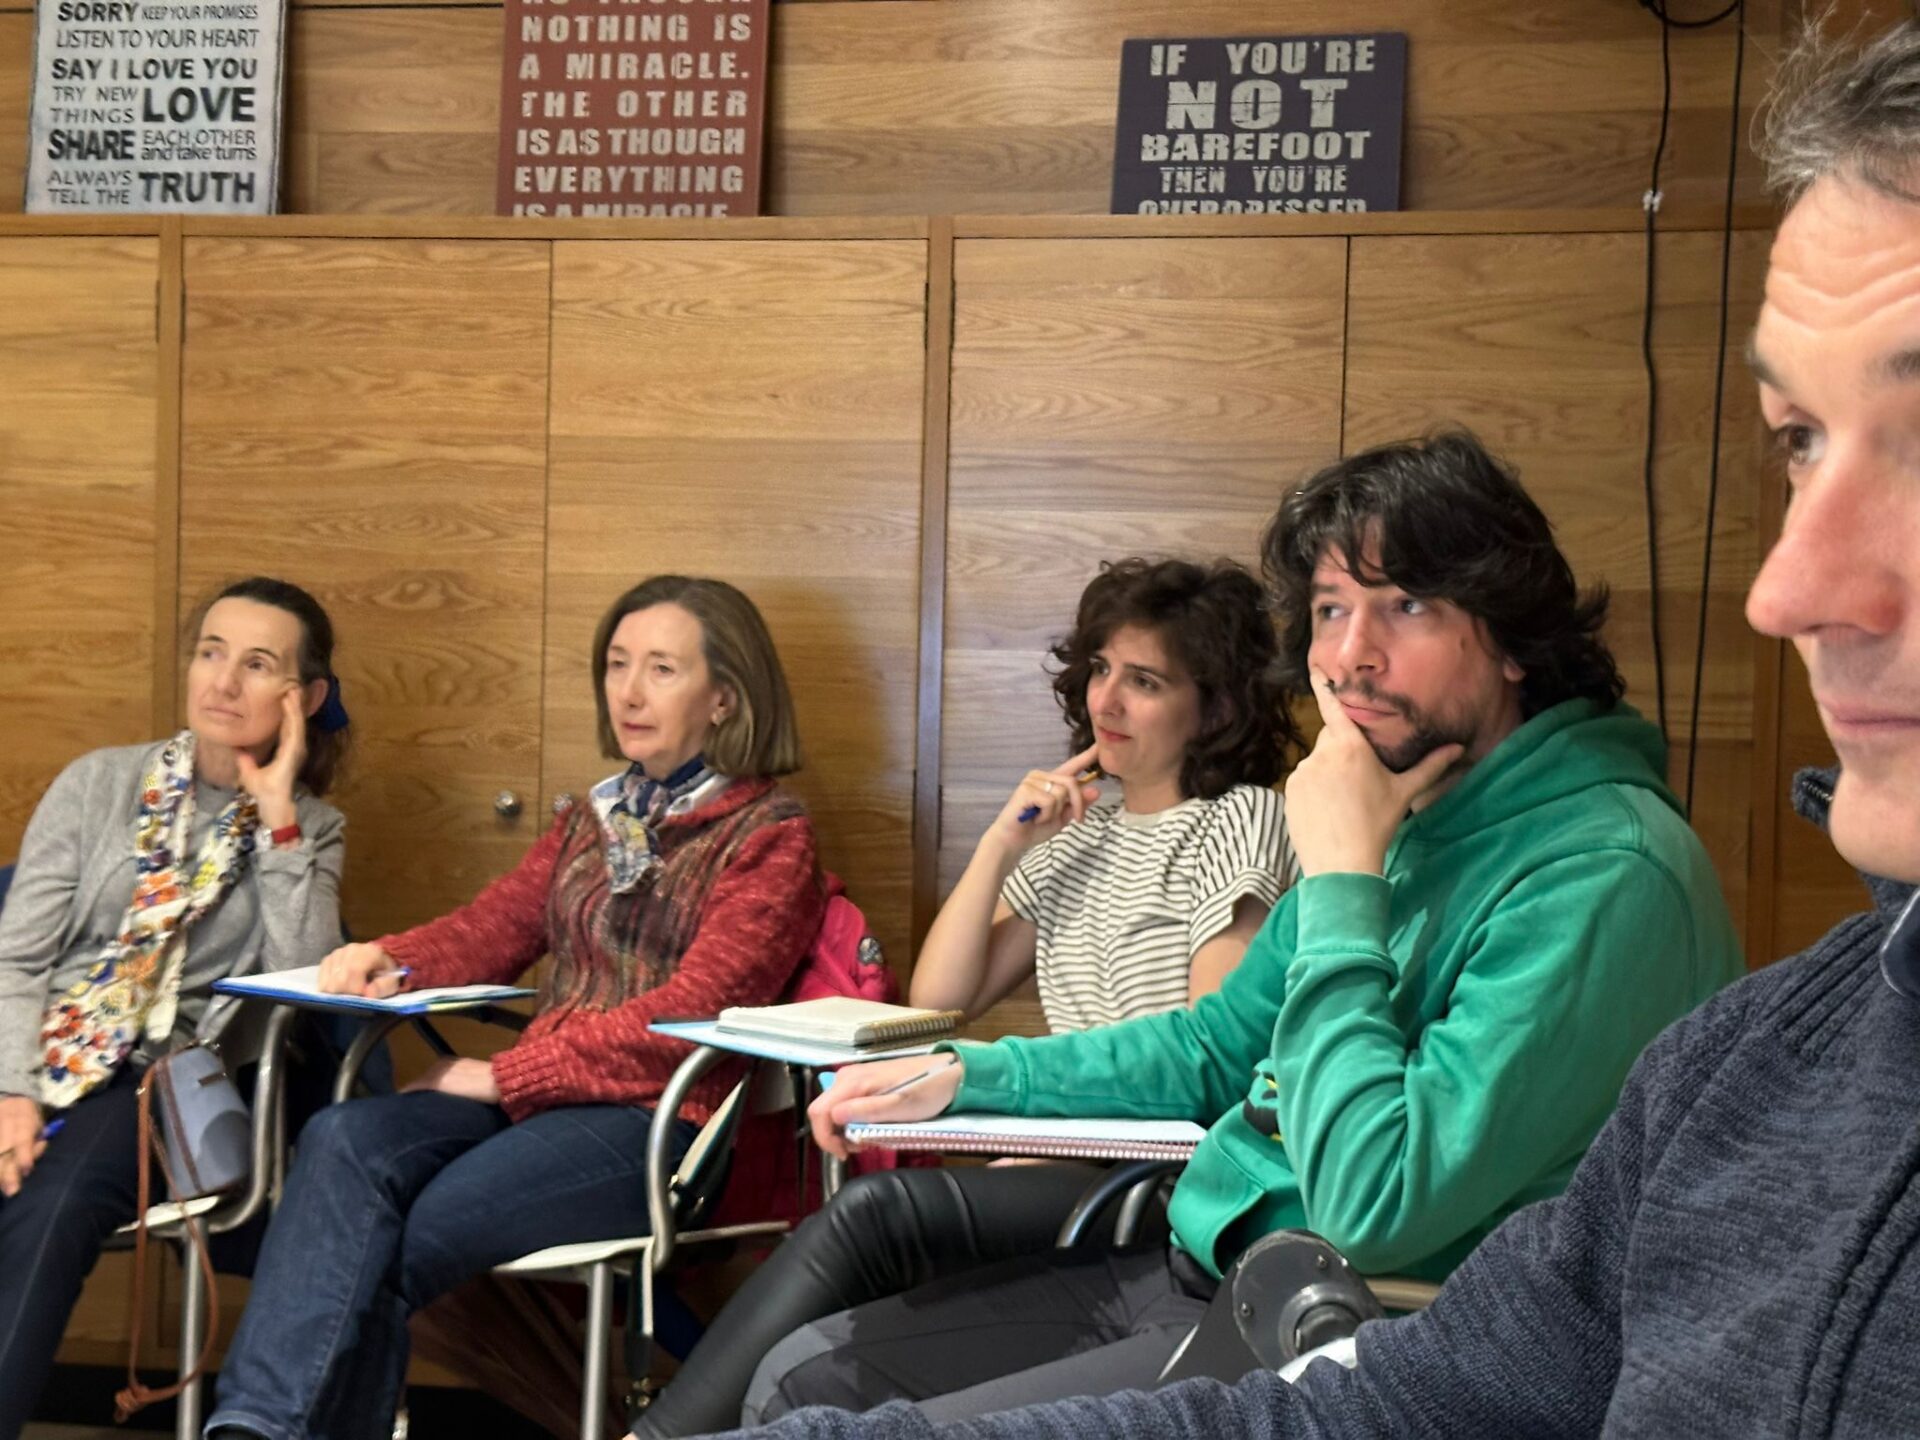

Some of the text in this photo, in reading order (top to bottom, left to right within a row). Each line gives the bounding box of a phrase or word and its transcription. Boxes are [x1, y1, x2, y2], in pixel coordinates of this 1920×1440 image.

[57, 2, 258, 22] SORRY KEEP YOUR PROMISES
[57, 29, 259, 48] LISTEN TO YOUR HEART
[521, 13, 751, 42] NOTHING IS
[52, 58, 257, 80] SAY I LOVE YOU
[518, 52, 749, 80] A MIRACLE.
[1150, 39, 1376, 76] IF YOU'RE
[53, 86, 138, 102] TRY NEW
[143, 87, 256, 123] LOVE
[521, 90, 748, 118] THE OTHER
[1165, 78, 1349, 130] NOT
[50, 108, 135, 124] THINGS
[48, 129, 136, 160] SHARE
[141, 144, 173, 160] and
[176, 143, 211, 160] take
[143, 130, 256, 145] EACH OTHER
[516, 128, 746, 155] IS AS THOUGH
[1140, 130, 1371, 162] BAREFOOT
[47, 170, 132, 186] ALWAYS
[139, 172, 255, 203] TRUTH
[514, 165, 744, 193] EVERYTHING
[1159, 165, 1347, 194] THEN YOU'RE
[48, 189, 130, 205] TELL THE
